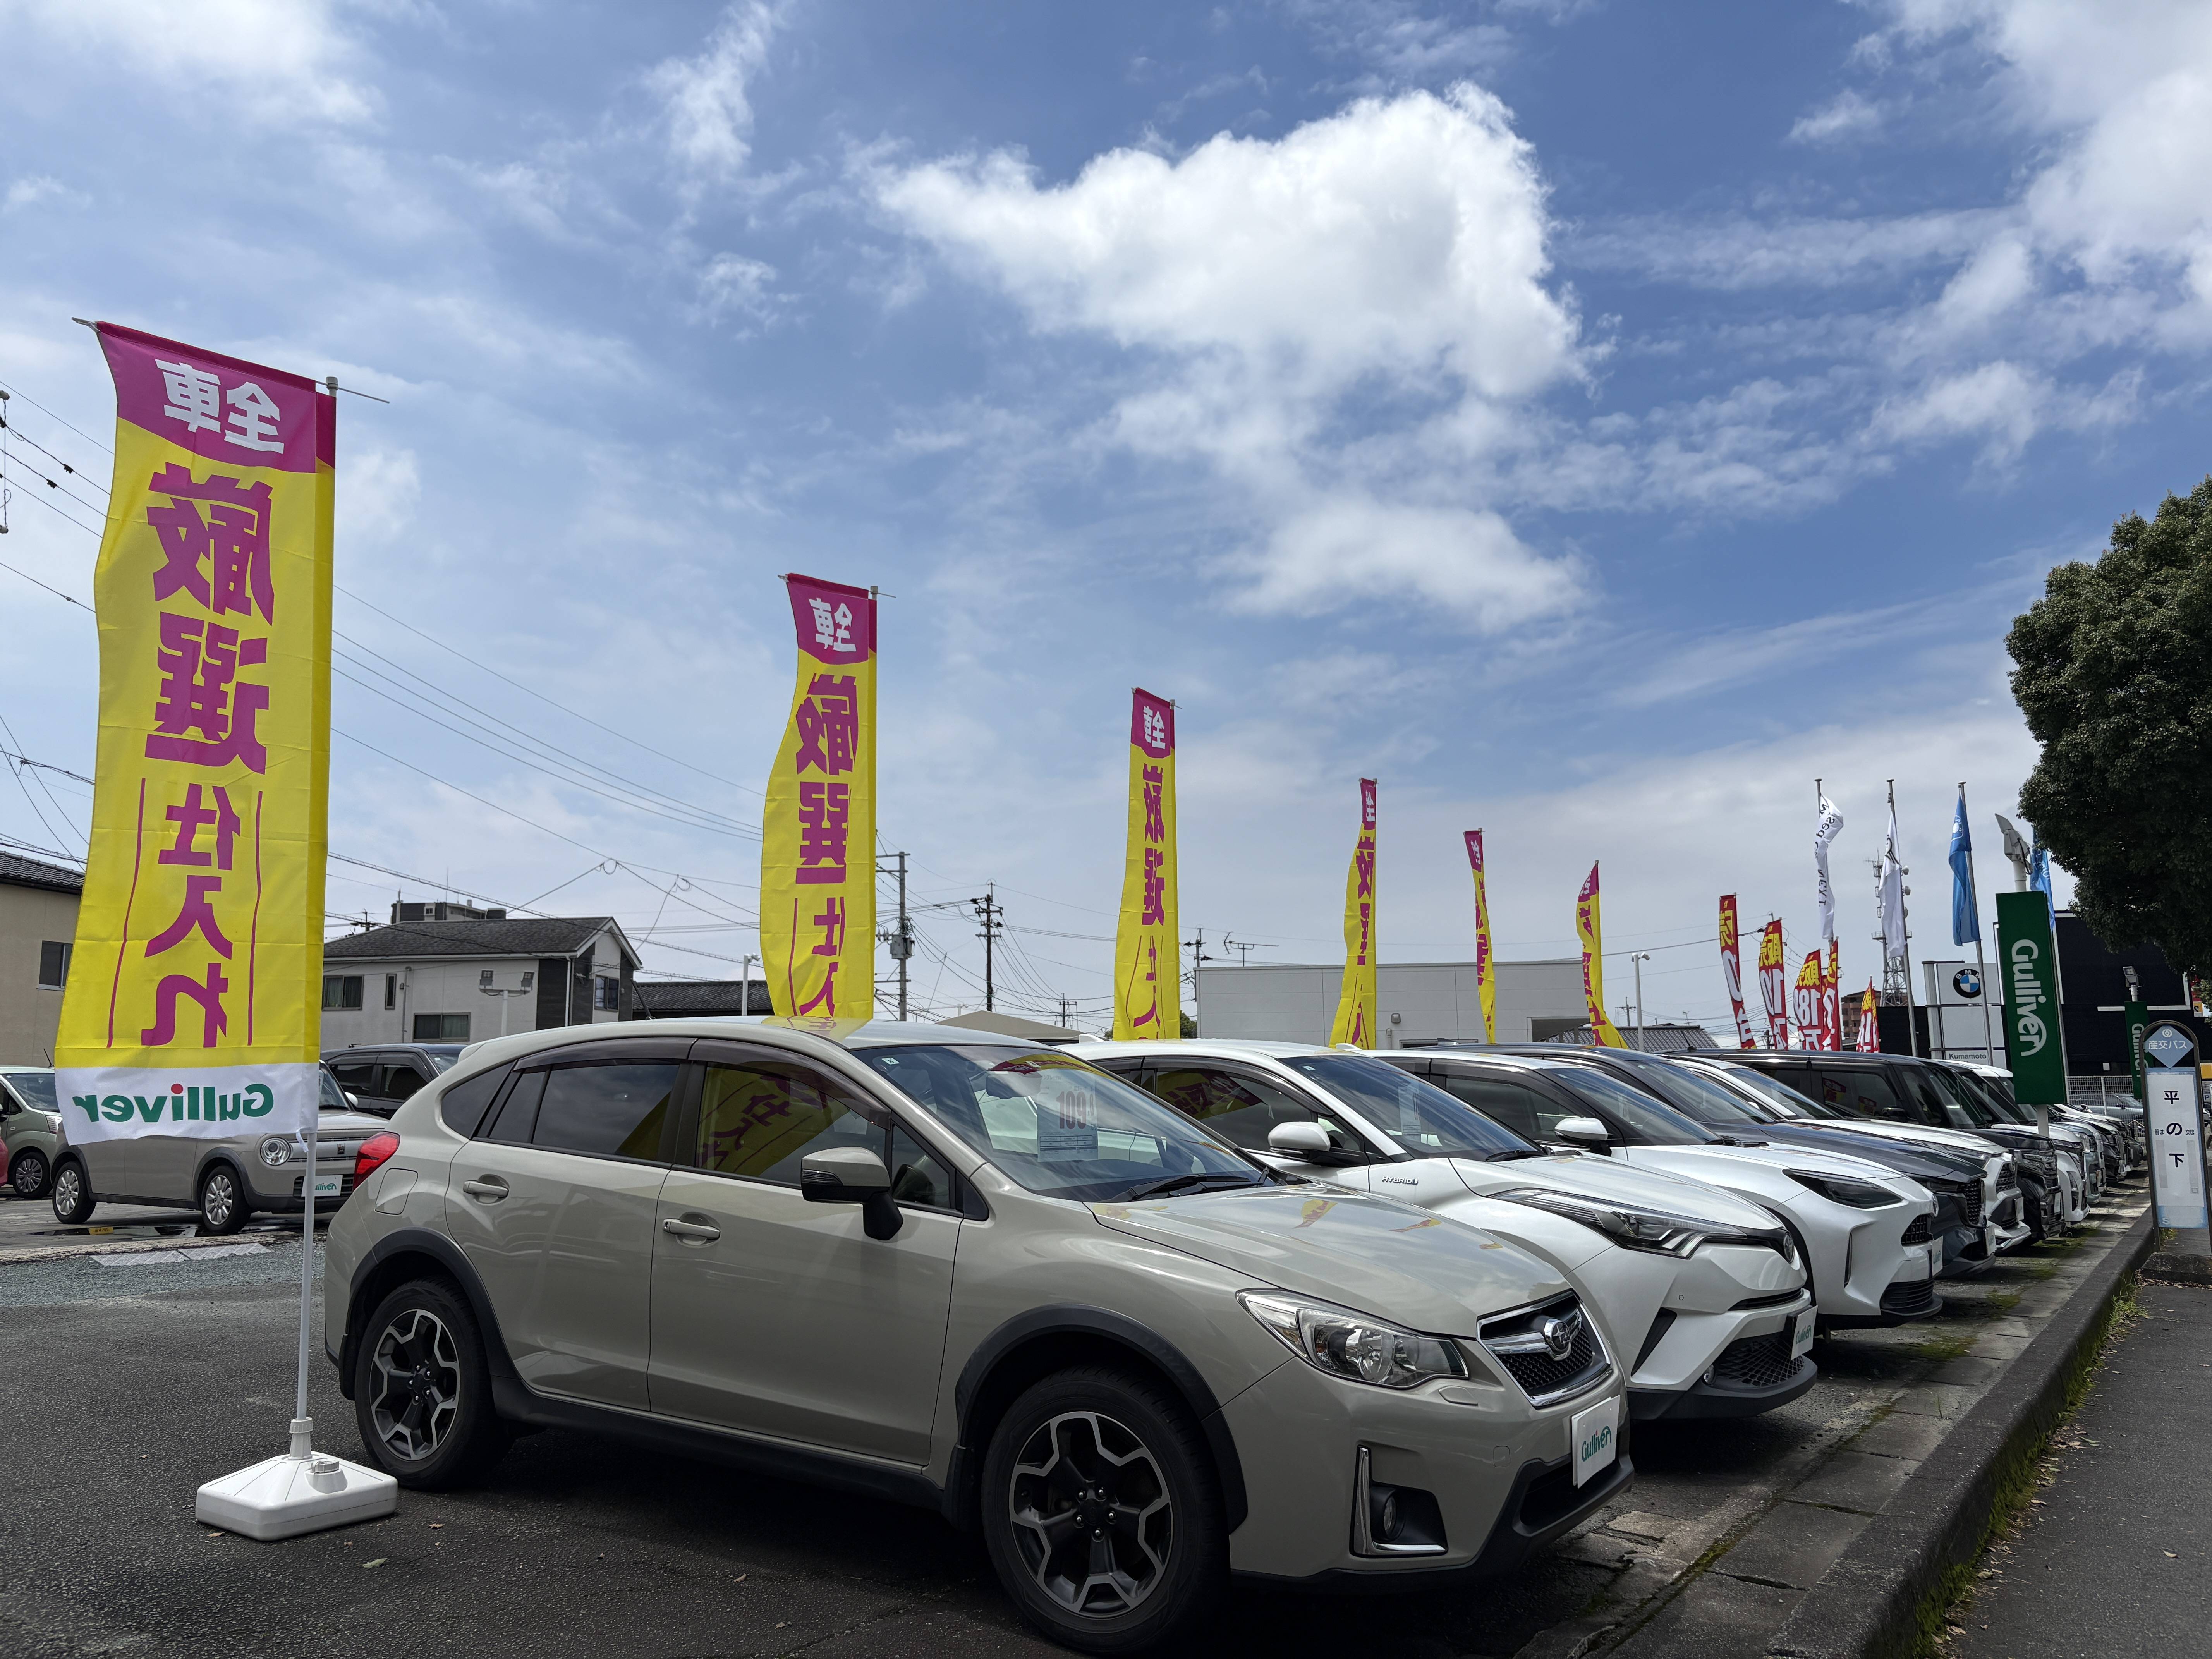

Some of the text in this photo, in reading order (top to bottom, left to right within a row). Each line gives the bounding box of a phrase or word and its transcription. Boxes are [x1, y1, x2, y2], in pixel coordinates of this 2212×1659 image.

[2011, 939, 2047, 1056] Gulliver
[2148, 1040, 2188, 1050] 産交バス
[2164, 1090, 2185, 1168] 平の下
[1382, 1175, 1413, 1184] HYBRID
[1582, 1426, 1611, 1462] Gulliver
